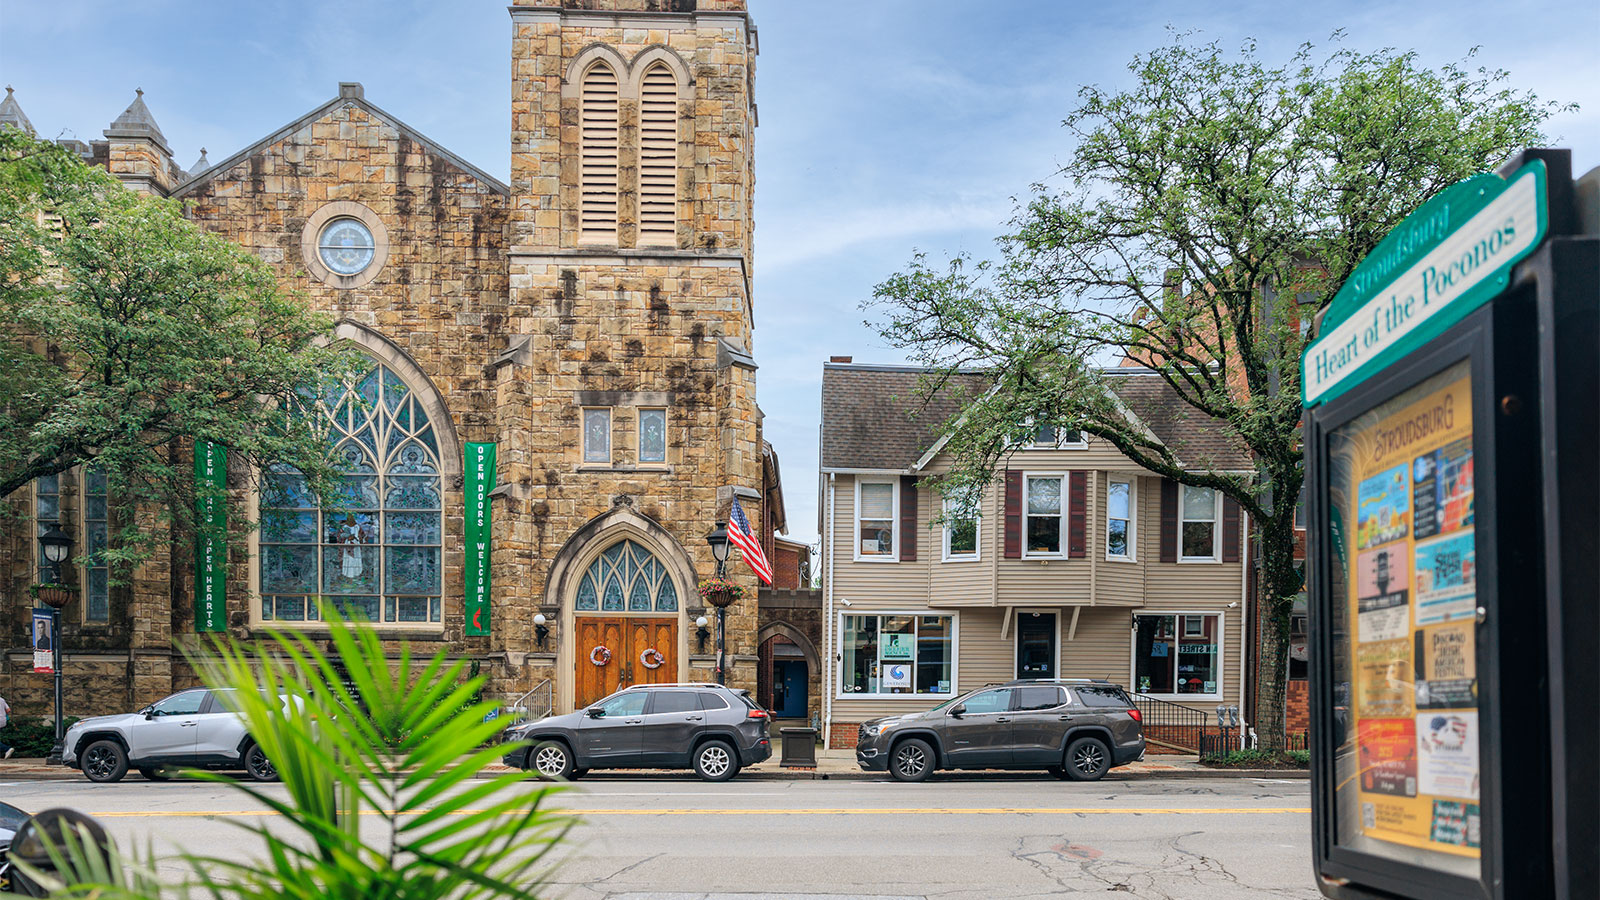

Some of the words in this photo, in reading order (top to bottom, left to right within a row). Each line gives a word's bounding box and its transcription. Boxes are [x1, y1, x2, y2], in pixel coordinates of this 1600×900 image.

[1315, 334, 1358, 385] Heart
[1363, 307, 1382, 349] of
[1385, 295, 1415, 333] the
[1420, 217, 1517, 305] Poconos
[206, 441, 214, 476] OPEN
[1373, 393, 1454, 462] STROUDSBURG
[477, 543, 485, 602] WELCOME
